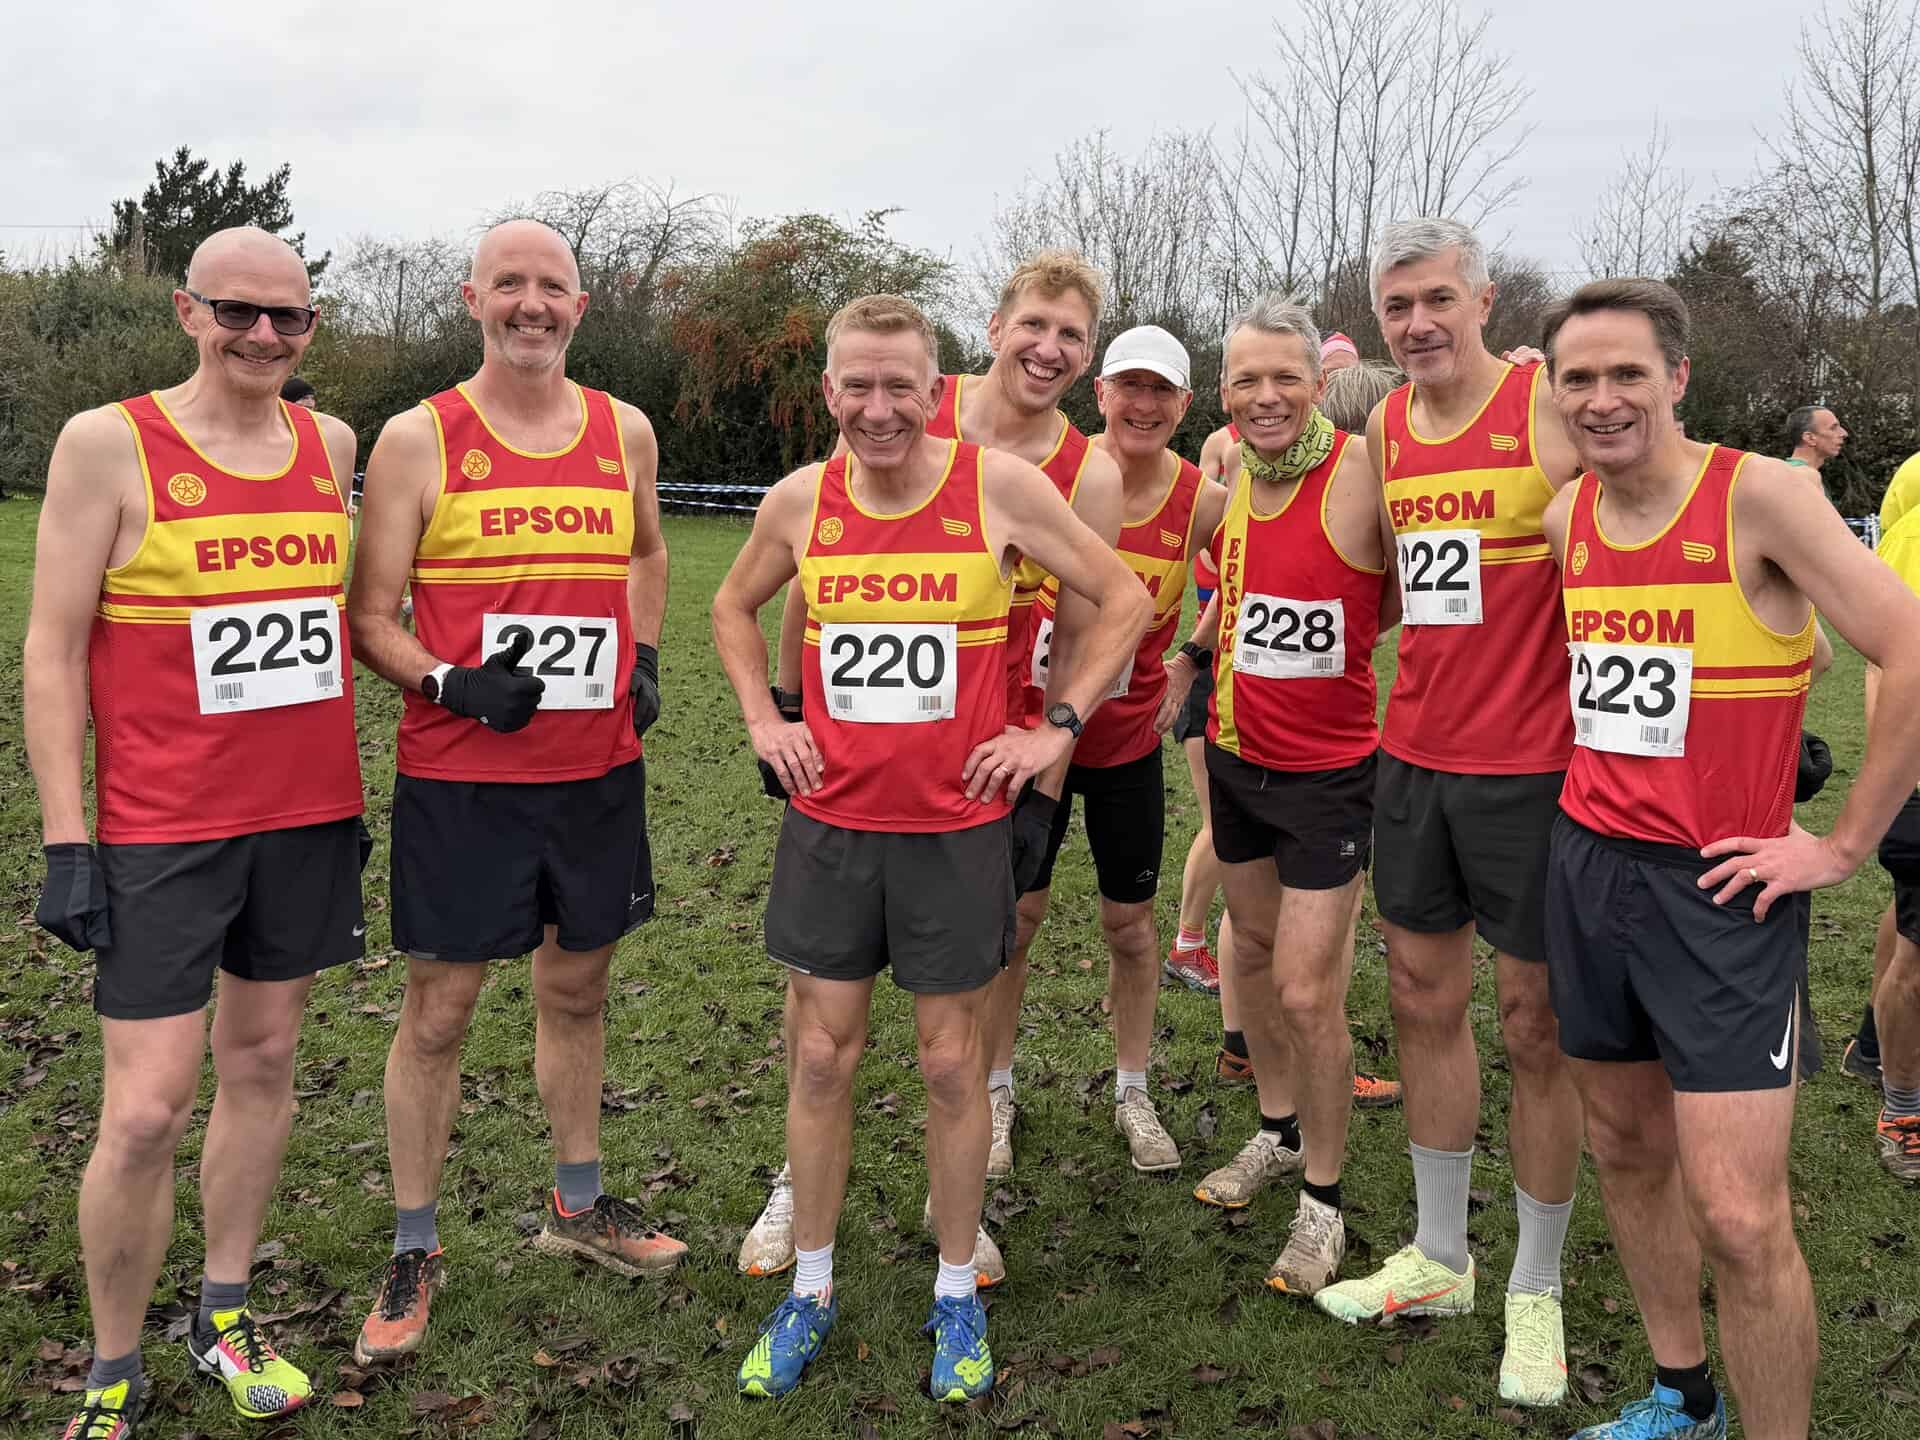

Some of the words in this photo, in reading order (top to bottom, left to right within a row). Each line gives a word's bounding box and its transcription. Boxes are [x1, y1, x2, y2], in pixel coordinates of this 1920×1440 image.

[480, 505, 613, 537] EPSOM
[1390, 490, 1495, 527] EPSOM
[195, 534, 337, 573] EPSOM
[817, 573, 957, 604] EPSOM
[1220, 538, 1241, 652] EPSOM
[208, 609, 333, 676] 225
[496, 624, 607, 677] 227
[1243, 602, 1336, 652] 228
[1571, 608, 1695, 643] EPSOM
[830, 634, 945, 689] 220
[1577, 653, 1676, 718] 223
